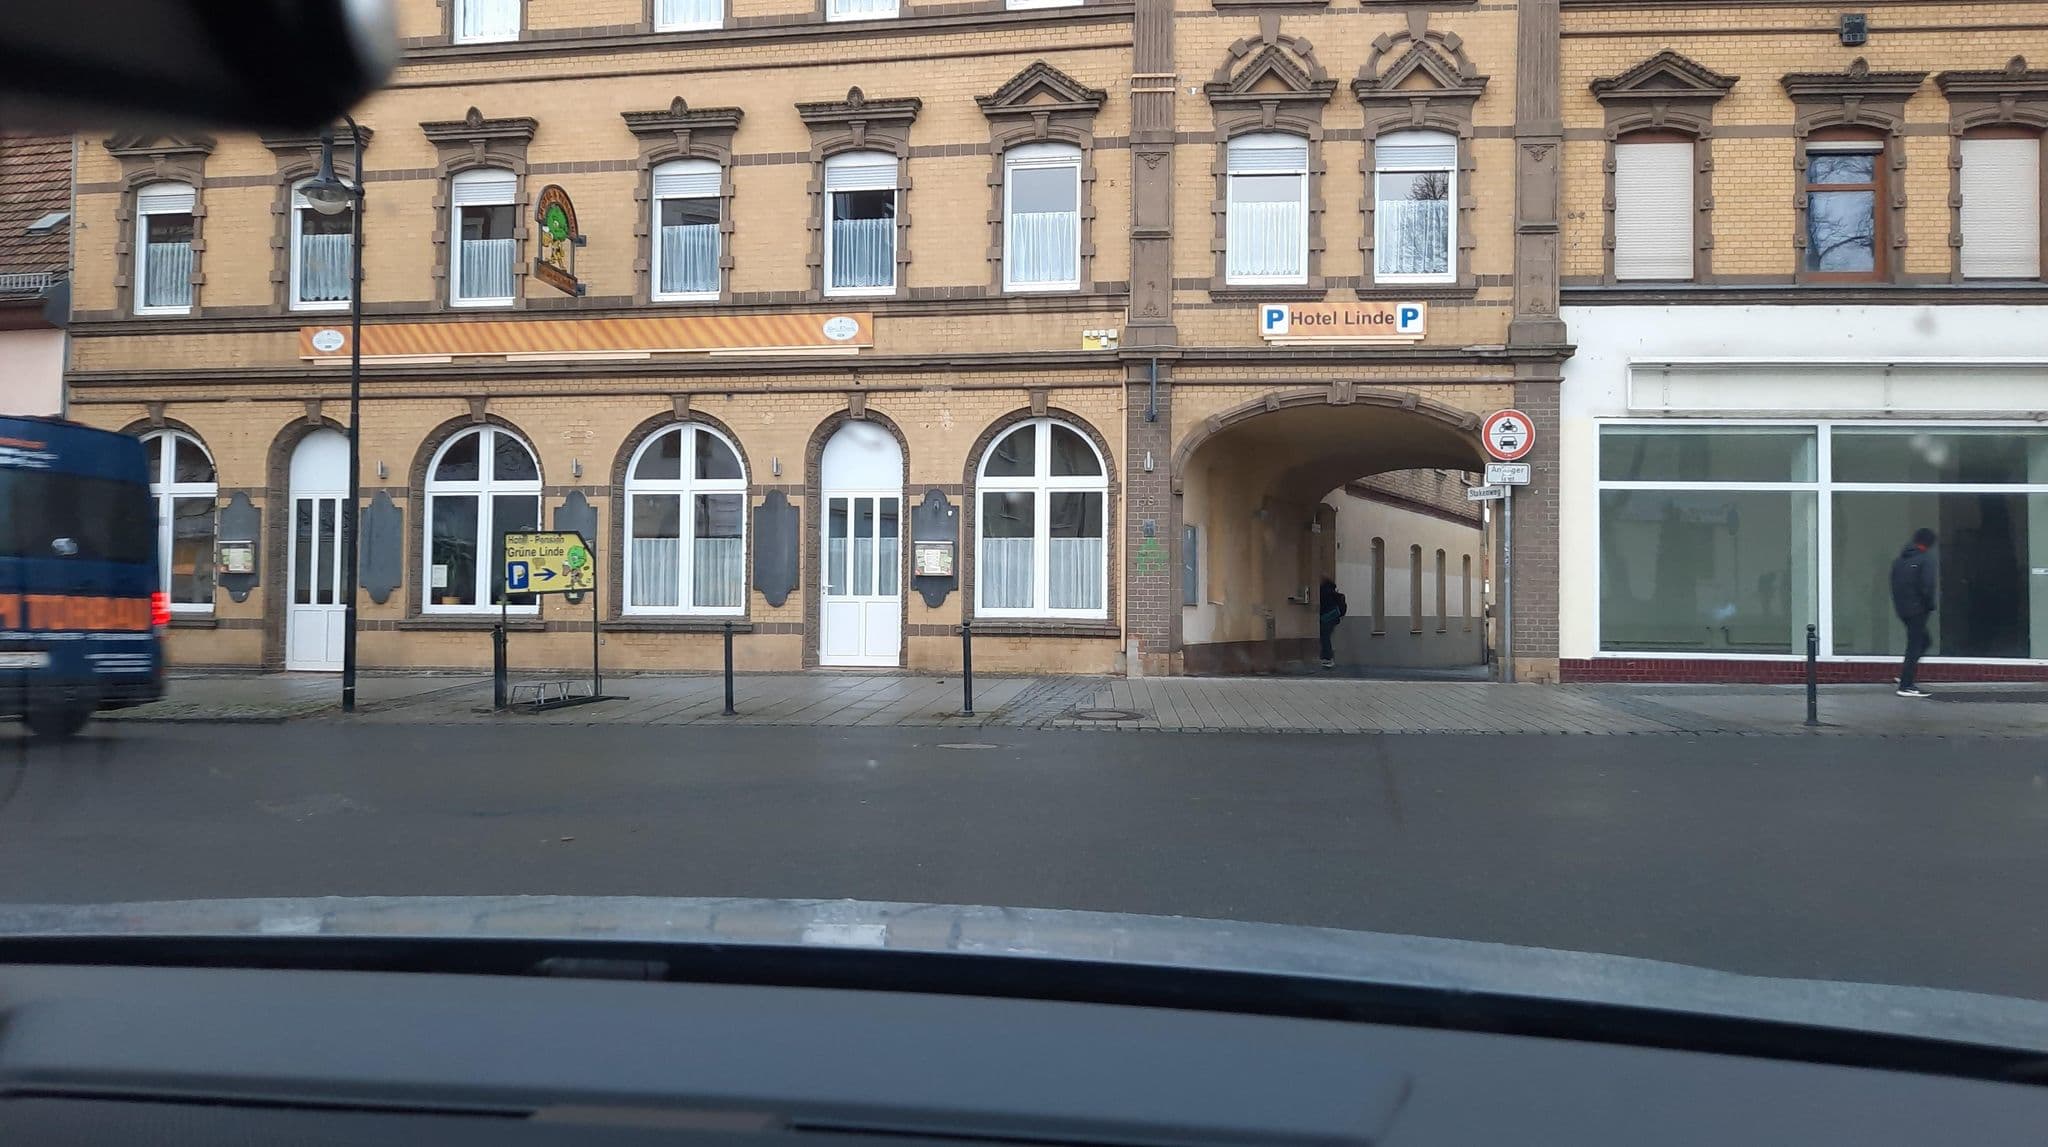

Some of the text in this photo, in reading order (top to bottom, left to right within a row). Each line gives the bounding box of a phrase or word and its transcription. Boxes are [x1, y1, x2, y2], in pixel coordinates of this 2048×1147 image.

[1267, 308, 1419, 329] P Hotel Linde P
[508, 547, 565, 557] Grüne Linde
